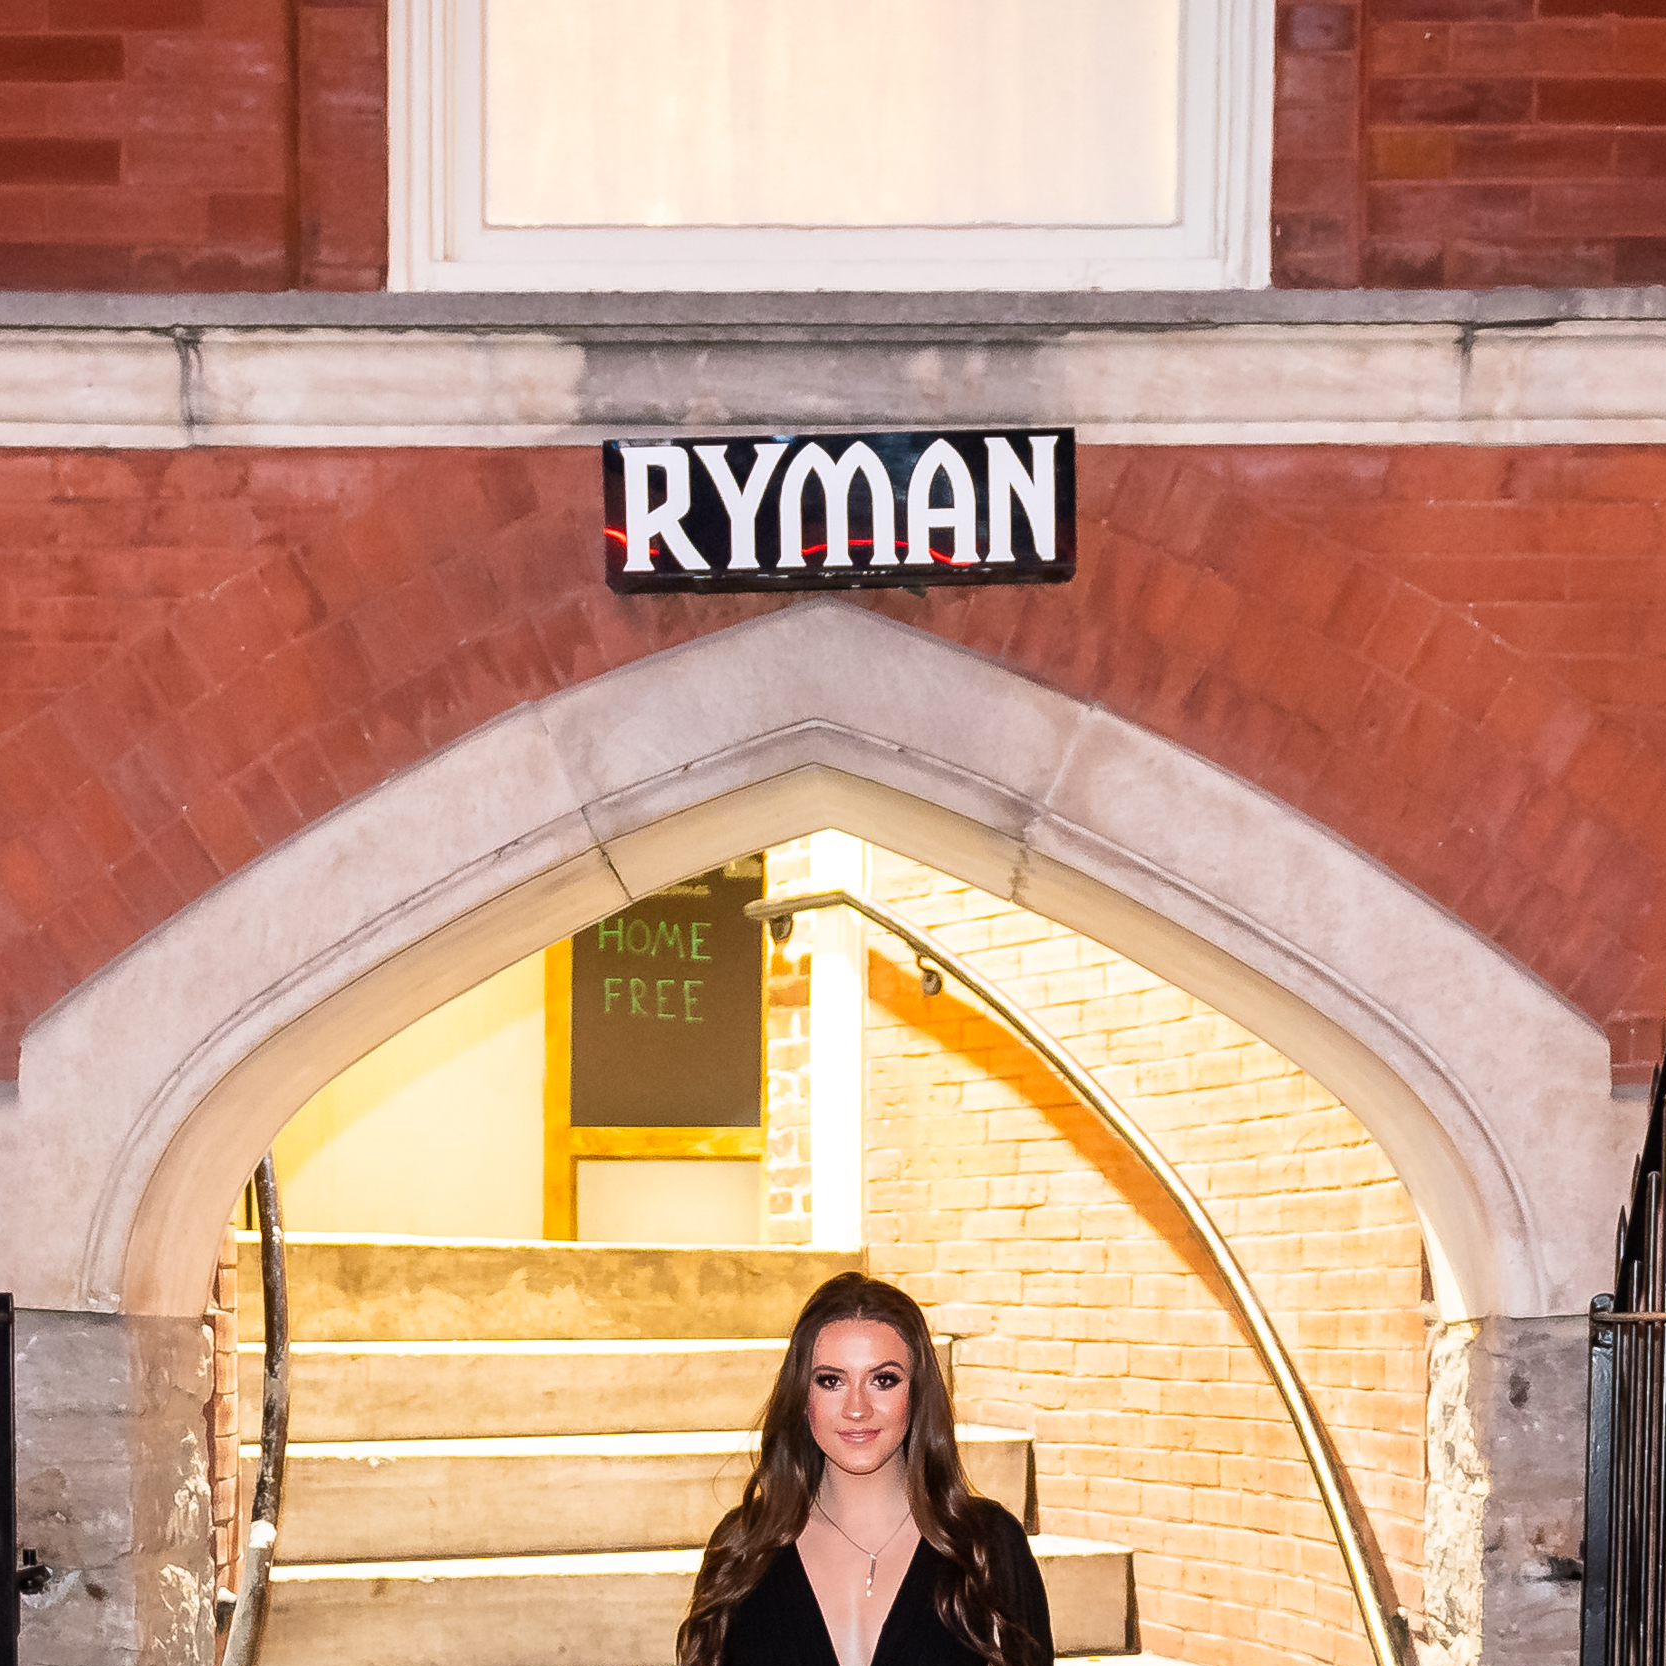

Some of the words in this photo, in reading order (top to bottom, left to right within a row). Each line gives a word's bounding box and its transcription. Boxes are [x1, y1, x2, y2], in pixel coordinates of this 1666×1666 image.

[621, 436, 1059, 572] RYMAN
[597, 918, 712, 961] HOME
[604, 977, 704, 1022] FREE
